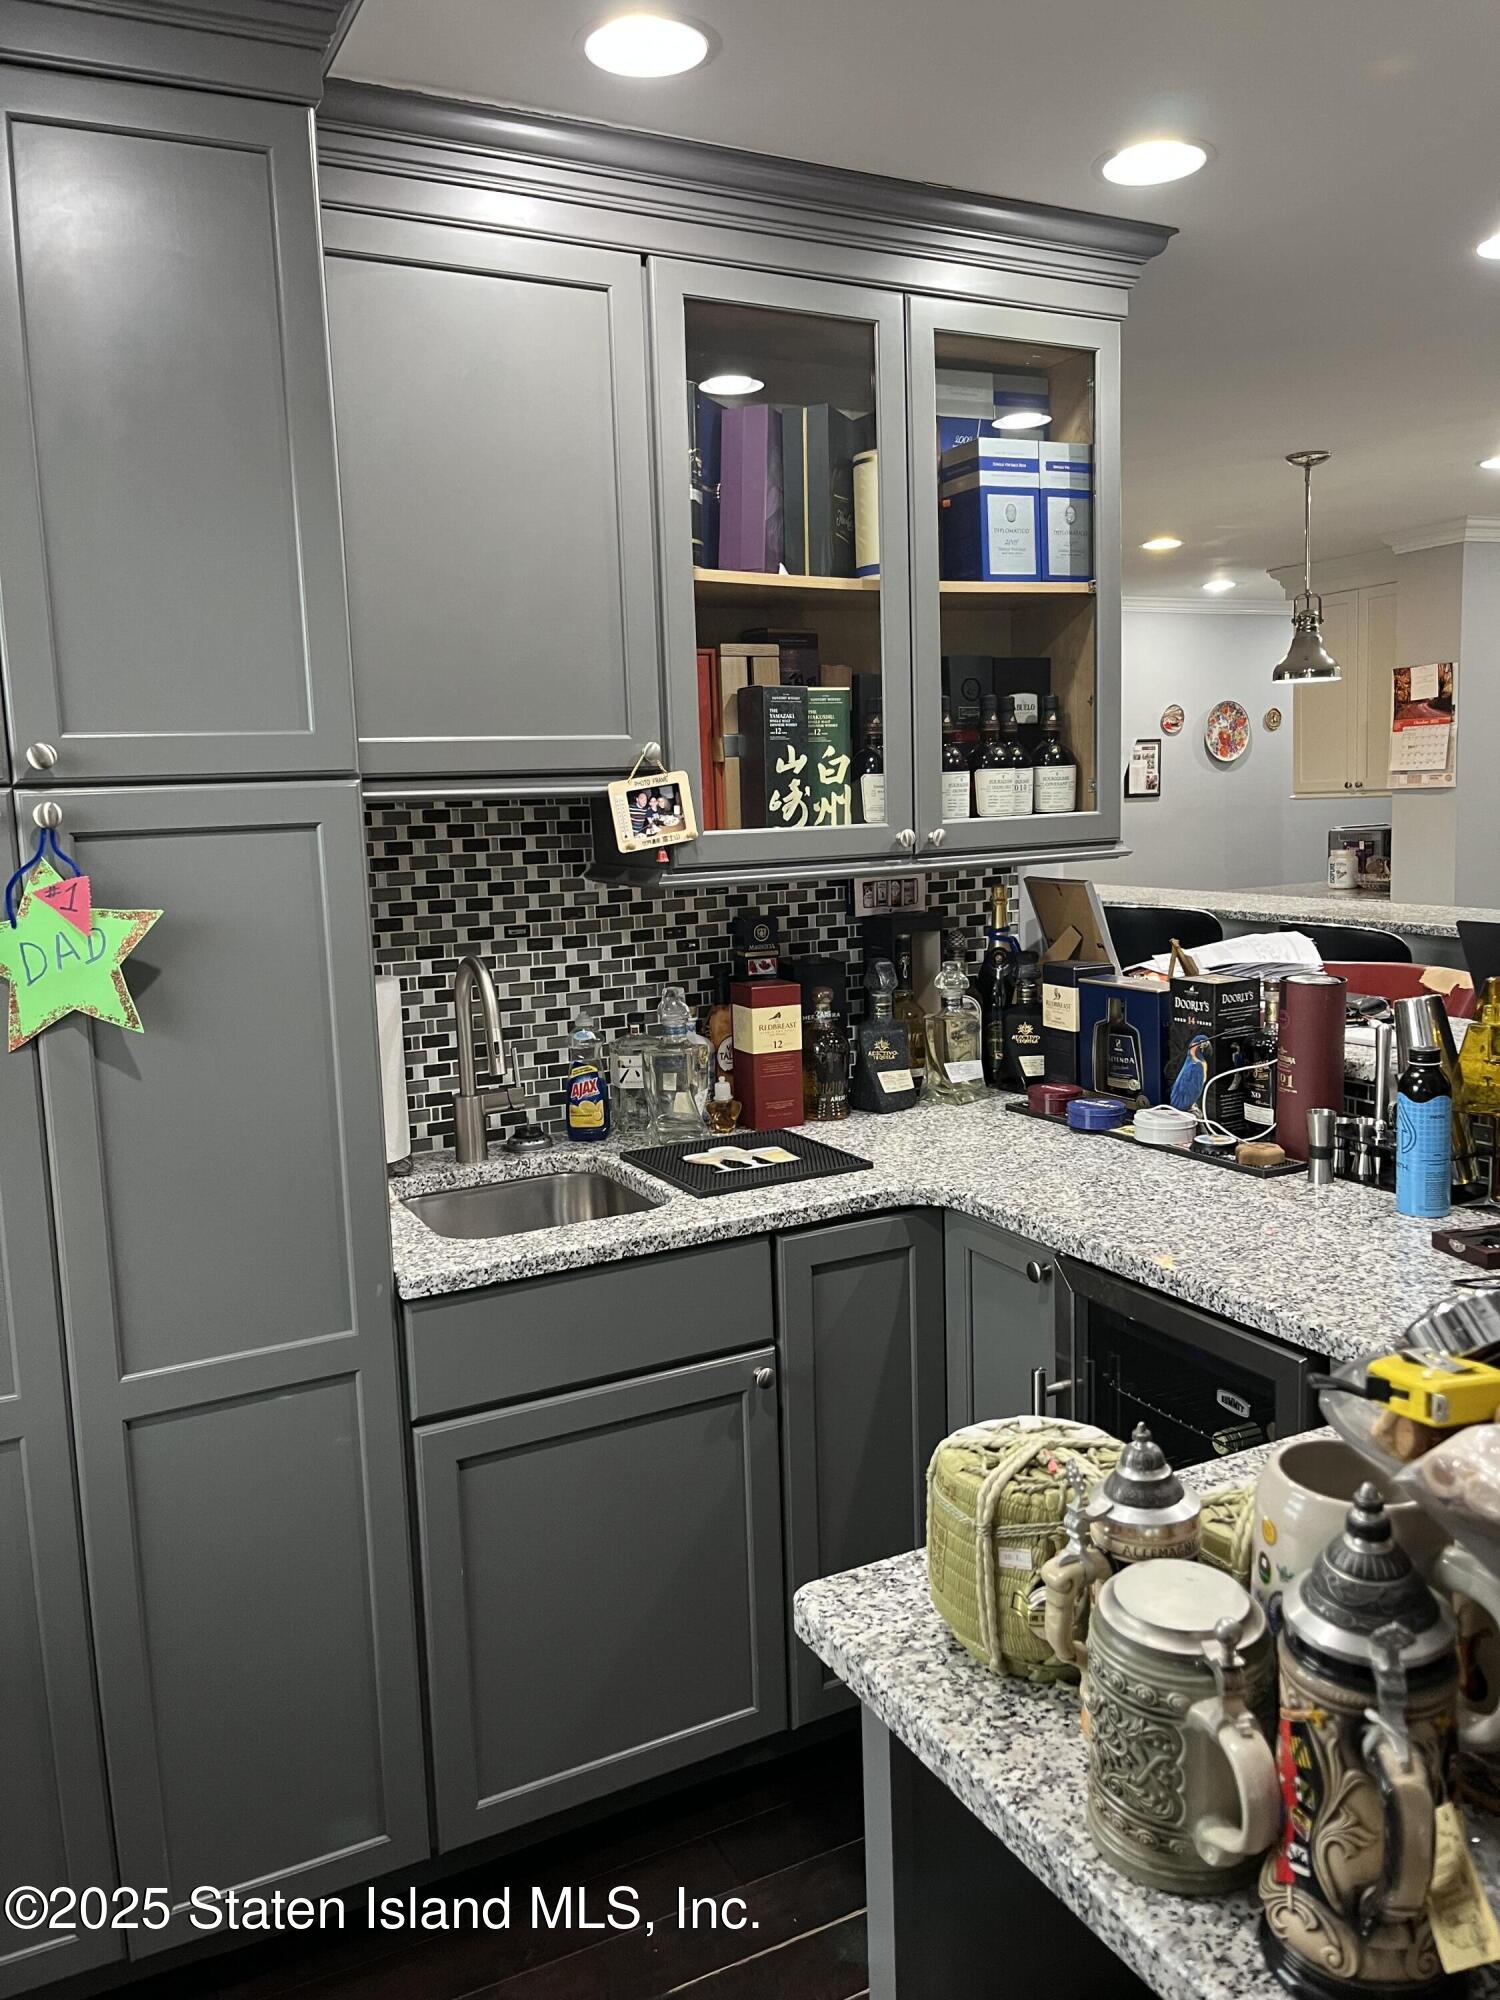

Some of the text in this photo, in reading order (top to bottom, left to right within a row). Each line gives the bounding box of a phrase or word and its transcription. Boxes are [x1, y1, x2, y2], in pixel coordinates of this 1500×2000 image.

[775, 727, 782, 735] 12
[814, 728, 822, 736] 12
[634, 778, 651, 787] PHOTO
[44, 882, 79, 913] #1
[19, 927, 107, 987] DAD
[1221, 990, 1255, 1004] DOORLY'S
[1174, 996, 1210, 1013] DOORLY'S
[1187, 1015, 1196, 1025] 14
[758, 1021, 797, 1031] REDBREAST
[773, 1039, 784, 1049] 12
[571, 1077, 598, 1099] AJAX
[1250, 1090, 1262, 1099] XO
[1221, 1395, 1245, 1414] SUMMIT
